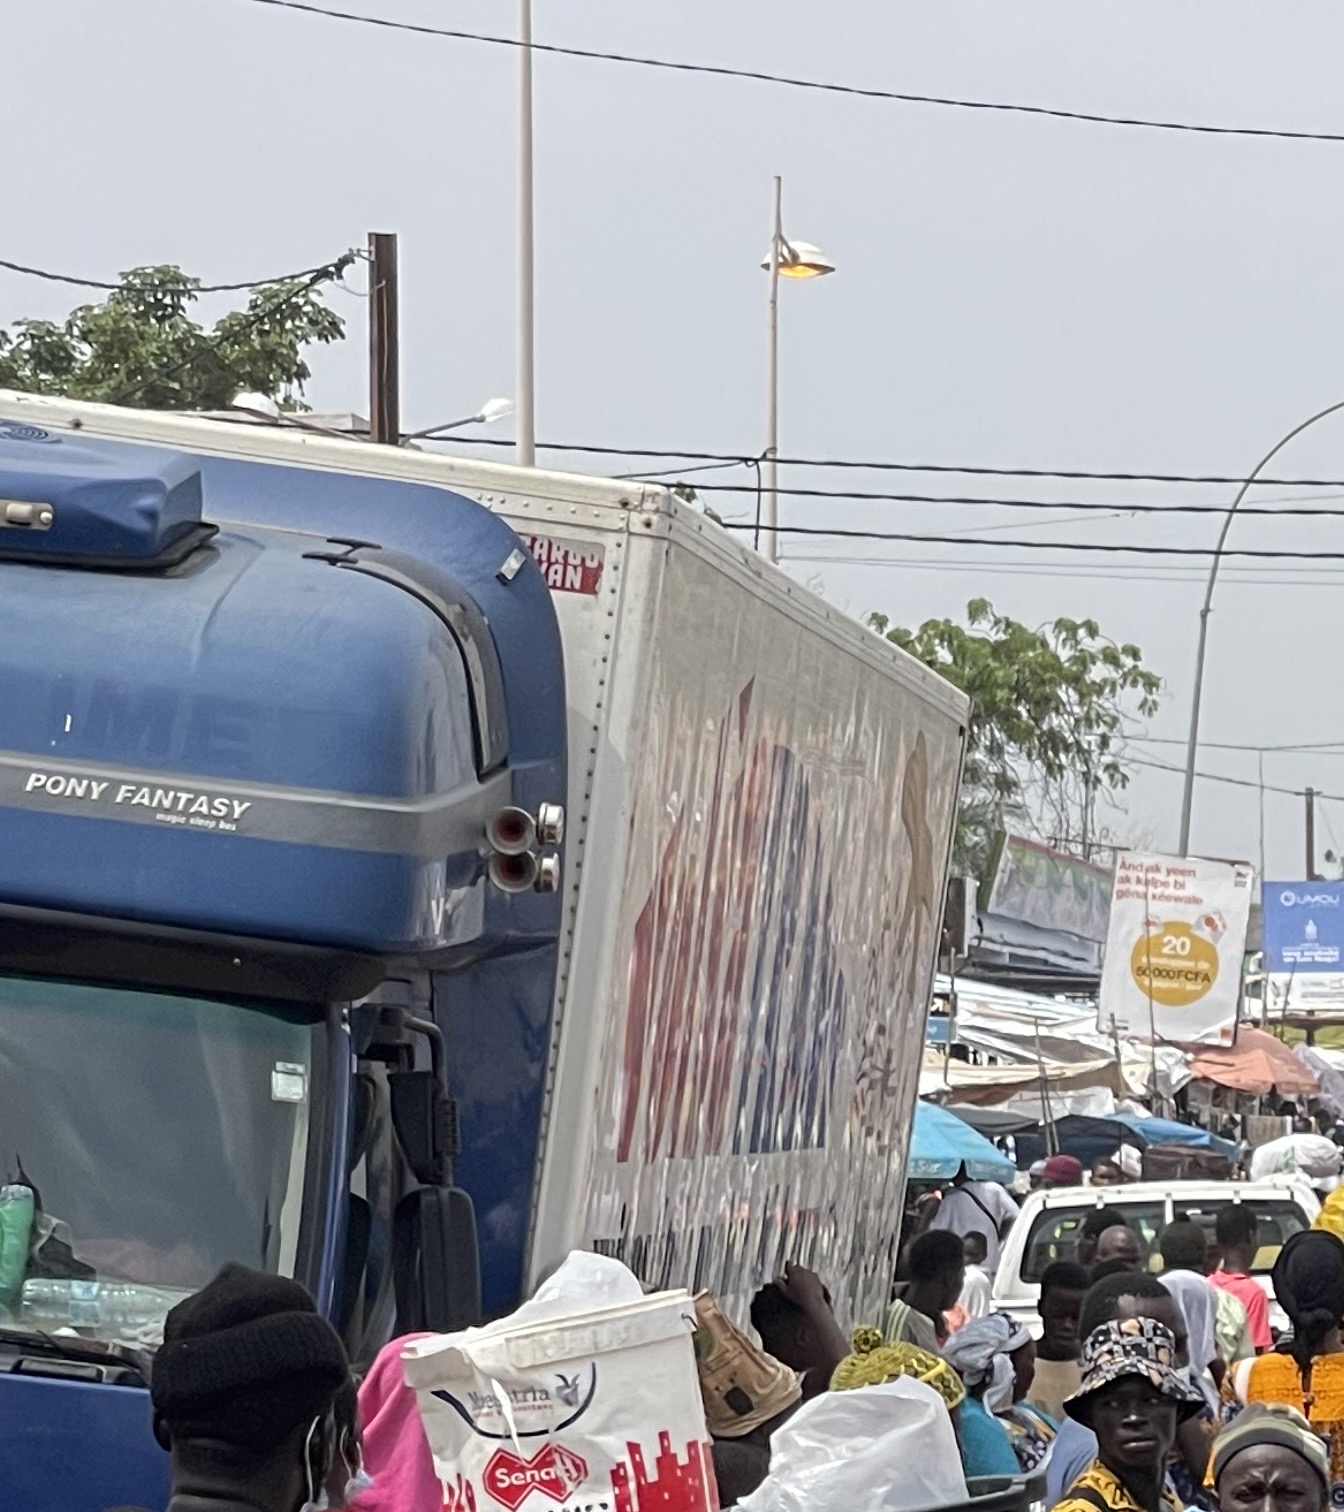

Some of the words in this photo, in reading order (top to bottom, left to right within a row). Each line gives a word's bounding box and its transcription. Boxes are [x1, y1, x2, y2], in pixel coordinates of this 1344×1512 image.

[25, 773, 109, 801] PONY
[115, 784, 251, 820] FANTASY
[1161, 935, 1191, 956] 20
